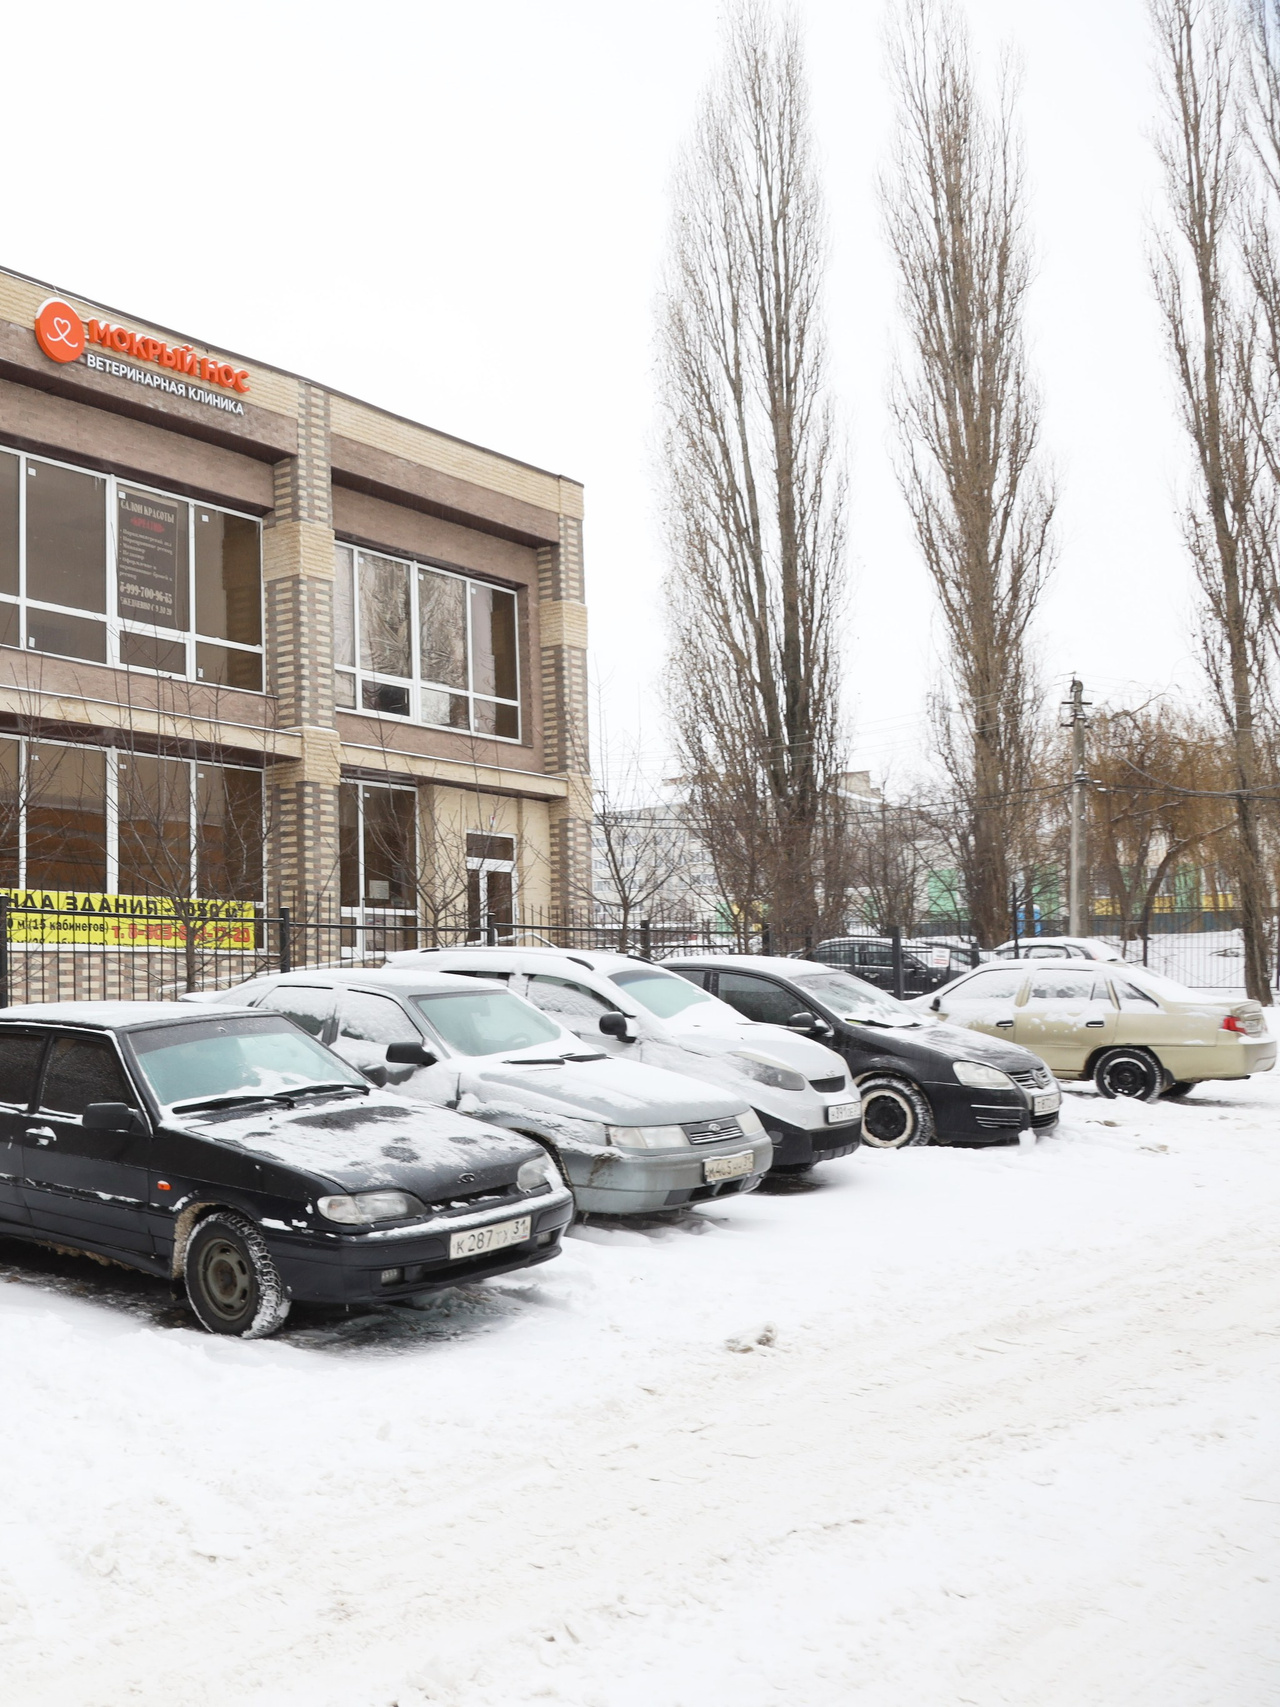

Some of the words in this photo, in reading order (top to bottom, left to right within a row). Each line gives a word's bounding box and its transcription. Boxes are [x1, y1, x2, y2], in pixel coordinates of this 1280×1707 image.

[88, 318, 198, 377] МОКРЫЙ
[201, 356, 251, 394] НОС
[87, 353, 186, 397] ВЕТЕРИНАРНАЯ
[188, 387, 245, 416] КЛИНИКА
[143, 505, 175, 524] КРАСОТЫ
[65, 895, 158, 915] ЗДАНИЯ
